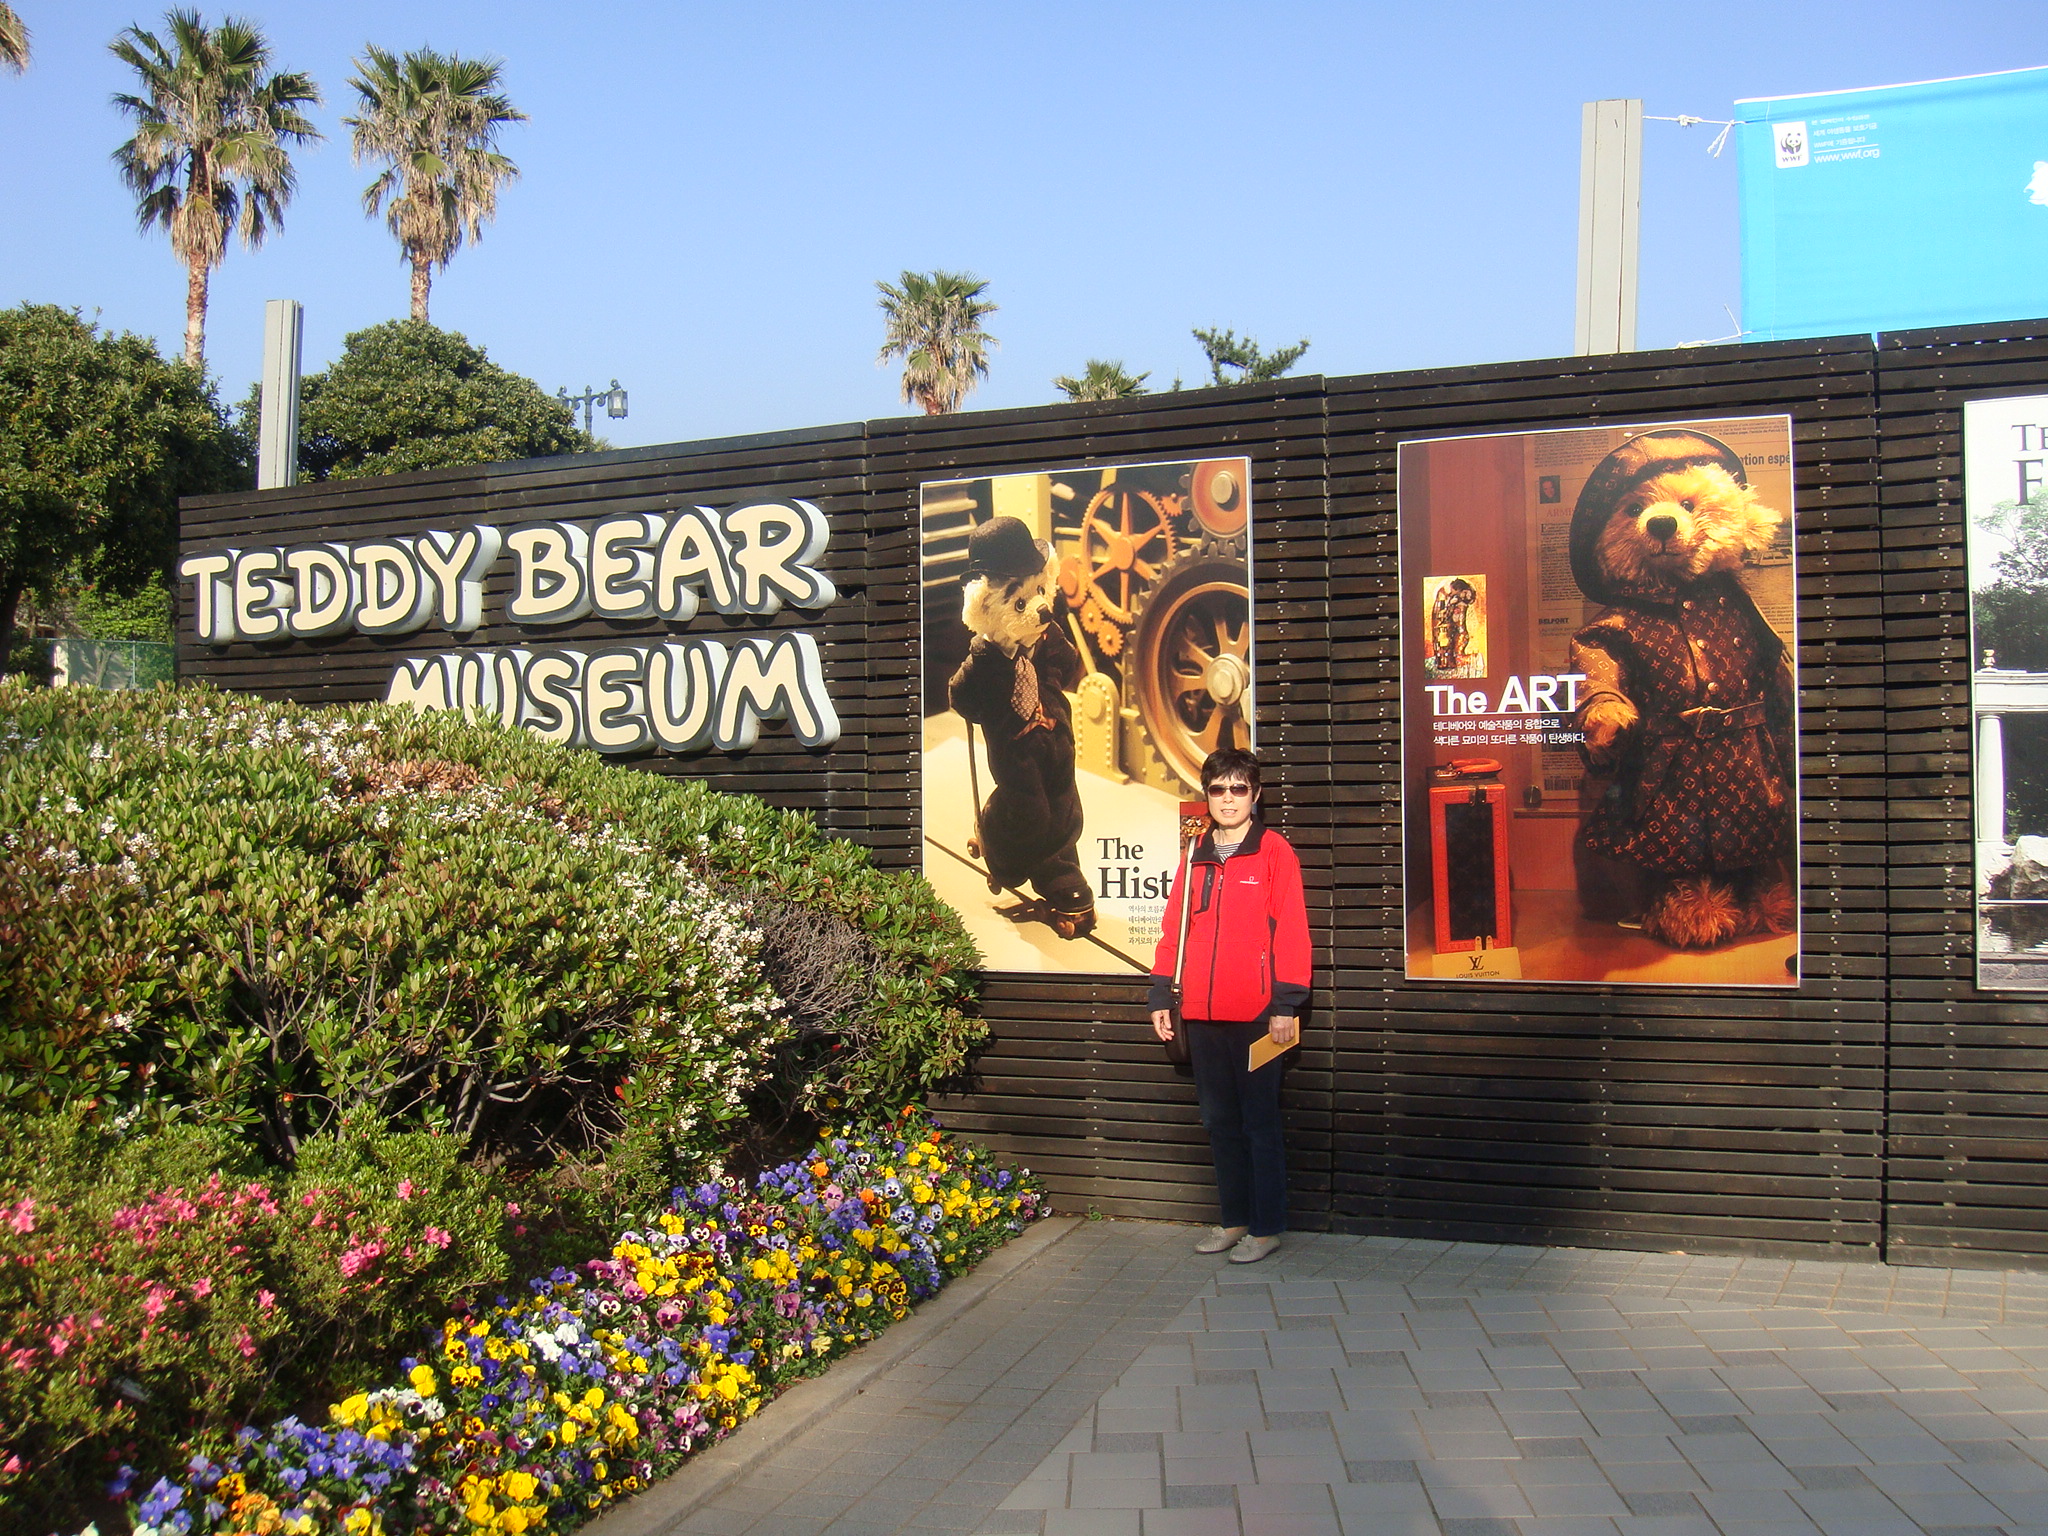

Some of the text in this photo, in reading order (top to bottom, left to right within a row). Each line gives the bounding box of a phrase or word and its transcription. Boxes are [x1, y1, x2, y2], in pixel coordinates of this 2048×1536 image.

[1814, 148, 1880, 164] www.wwf.org
[2011, 458, 2044, 507] F
[177, 498, 836, 646] TEDDY BEAR
[1424, 673, 1587, 716] The ART
[1432, 720, 1477, 731] 테디베어와
[1478, 719, 1522, 731] 예술작품의
[1432, 732, 1587, 746] 색다른 묘미의 또다른 작품이 탄생하다.
[1096, 837, 1144, 860] The
[1097, 866, 1173, 900] Hist
